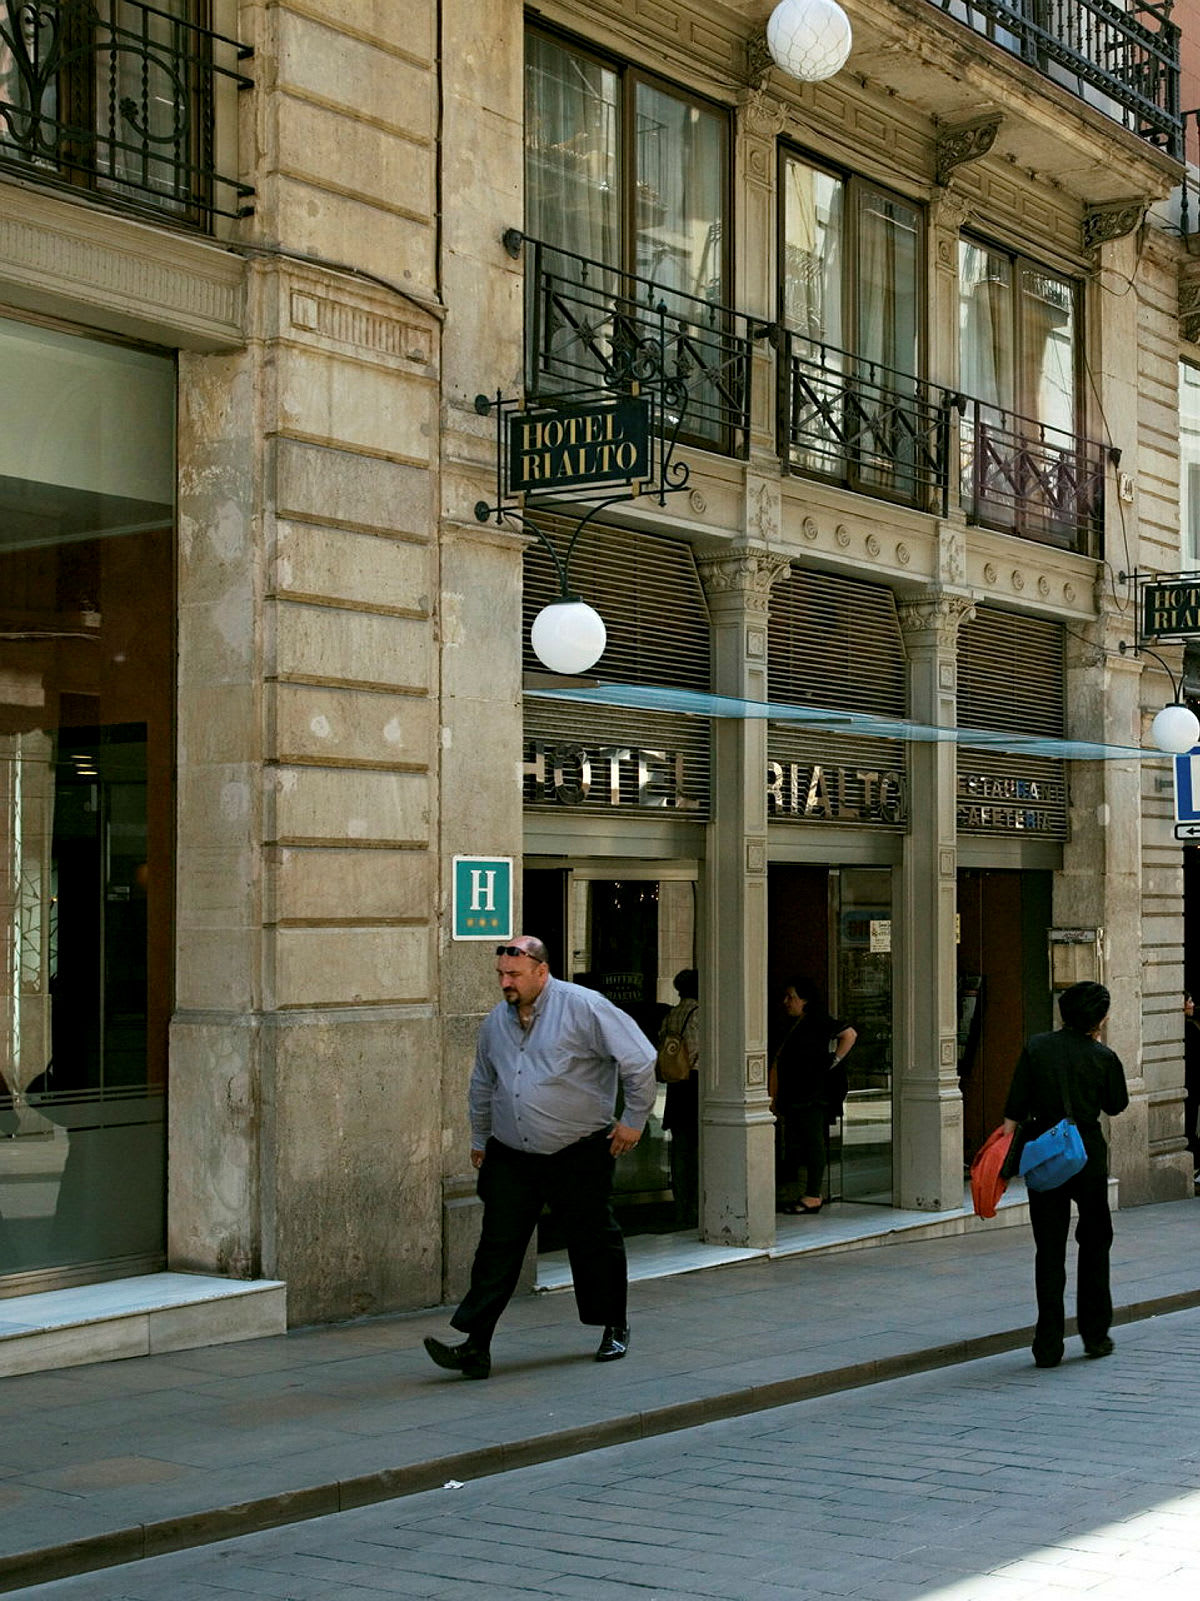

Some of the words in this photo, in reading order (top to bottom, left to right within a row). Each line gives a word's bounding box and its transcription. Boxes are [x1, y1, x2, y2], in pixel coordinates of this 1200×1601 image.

[521, 413, 624, 449] HOTEL
[520, 441, 637, 481] RIALTO
[523, 741, 700, 808] HOTEL
[768, 761, 906, 823] RIALTO
[470, 869, 497, 911] H
